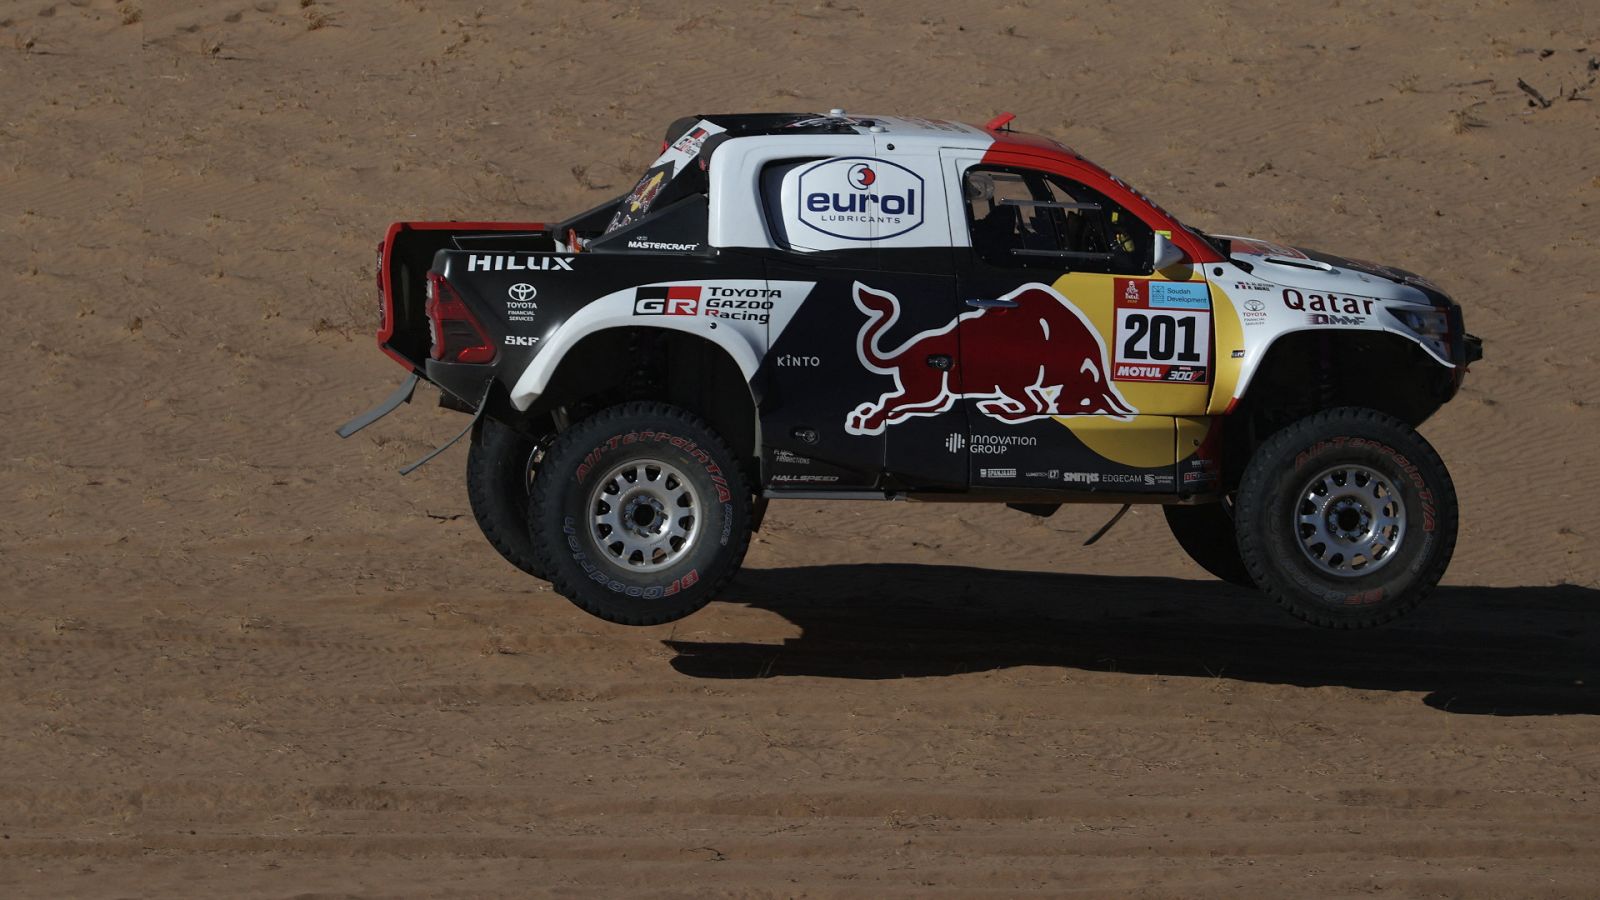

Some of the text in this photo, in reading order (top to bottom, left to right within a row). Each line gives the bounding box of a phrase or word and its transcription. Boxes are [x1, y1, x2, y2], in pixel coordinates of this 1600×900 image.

[806, 188, 915, 216] eurol
[821, 215, 901, 224] LUBRICANTS
[627, 240, 697, 251] MASTERCRAFT
[467, 254, 576, 272] HILUX
[708, 286, 782, 299] TOYOTA
[1167, 287, 1191, 295] Soudah
[506, 301, 538, 309] TOYOTA
[706, 298, 774, 310] GAZOO
[1167, 296, 1207, 304] Development
[1282, 288, 1374, 315] Qatar
[635, 298, 698, 315] GR
[705, 309, 770, 324] Racing
[504, 335, 540, 346] SKF
[1123, 313, 1201, 362] 201
[1116, 365, 1162, 378] MOTUL
[970, 434, 1038, 446] INNOVATION
[969, 445, 1008, 454] GROUP
[1102, 474, 1142, 483] EDGECAM
